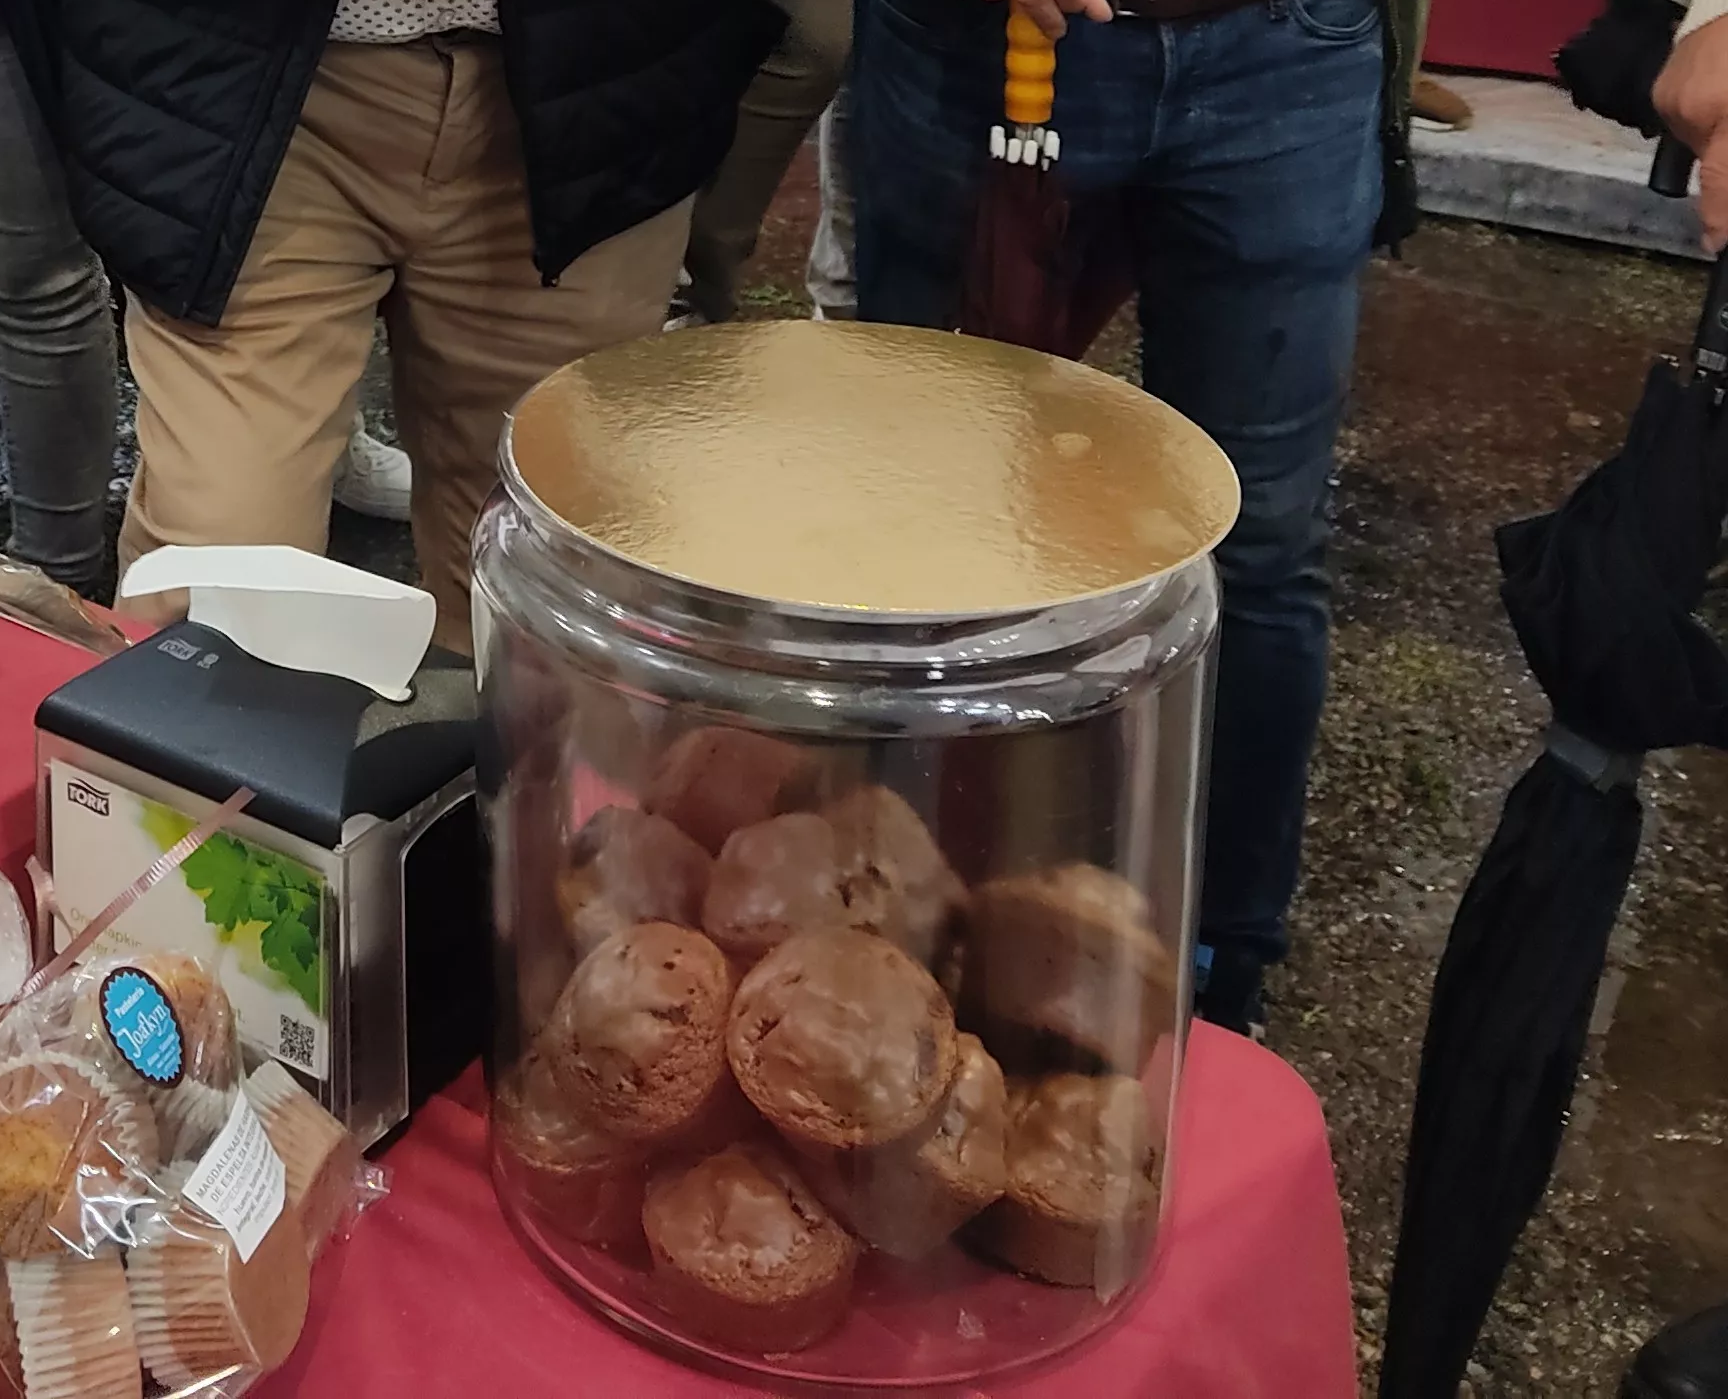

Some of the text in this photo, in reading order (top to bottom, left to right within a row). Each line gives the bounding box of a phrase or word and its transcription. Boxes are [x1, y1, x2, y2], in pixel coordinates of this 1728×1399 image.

[69, 784, 108, 815] TORK
[195, 1137, 240, 1199] MAGDALENAS
[210, 1188, 224, 1203] DE
